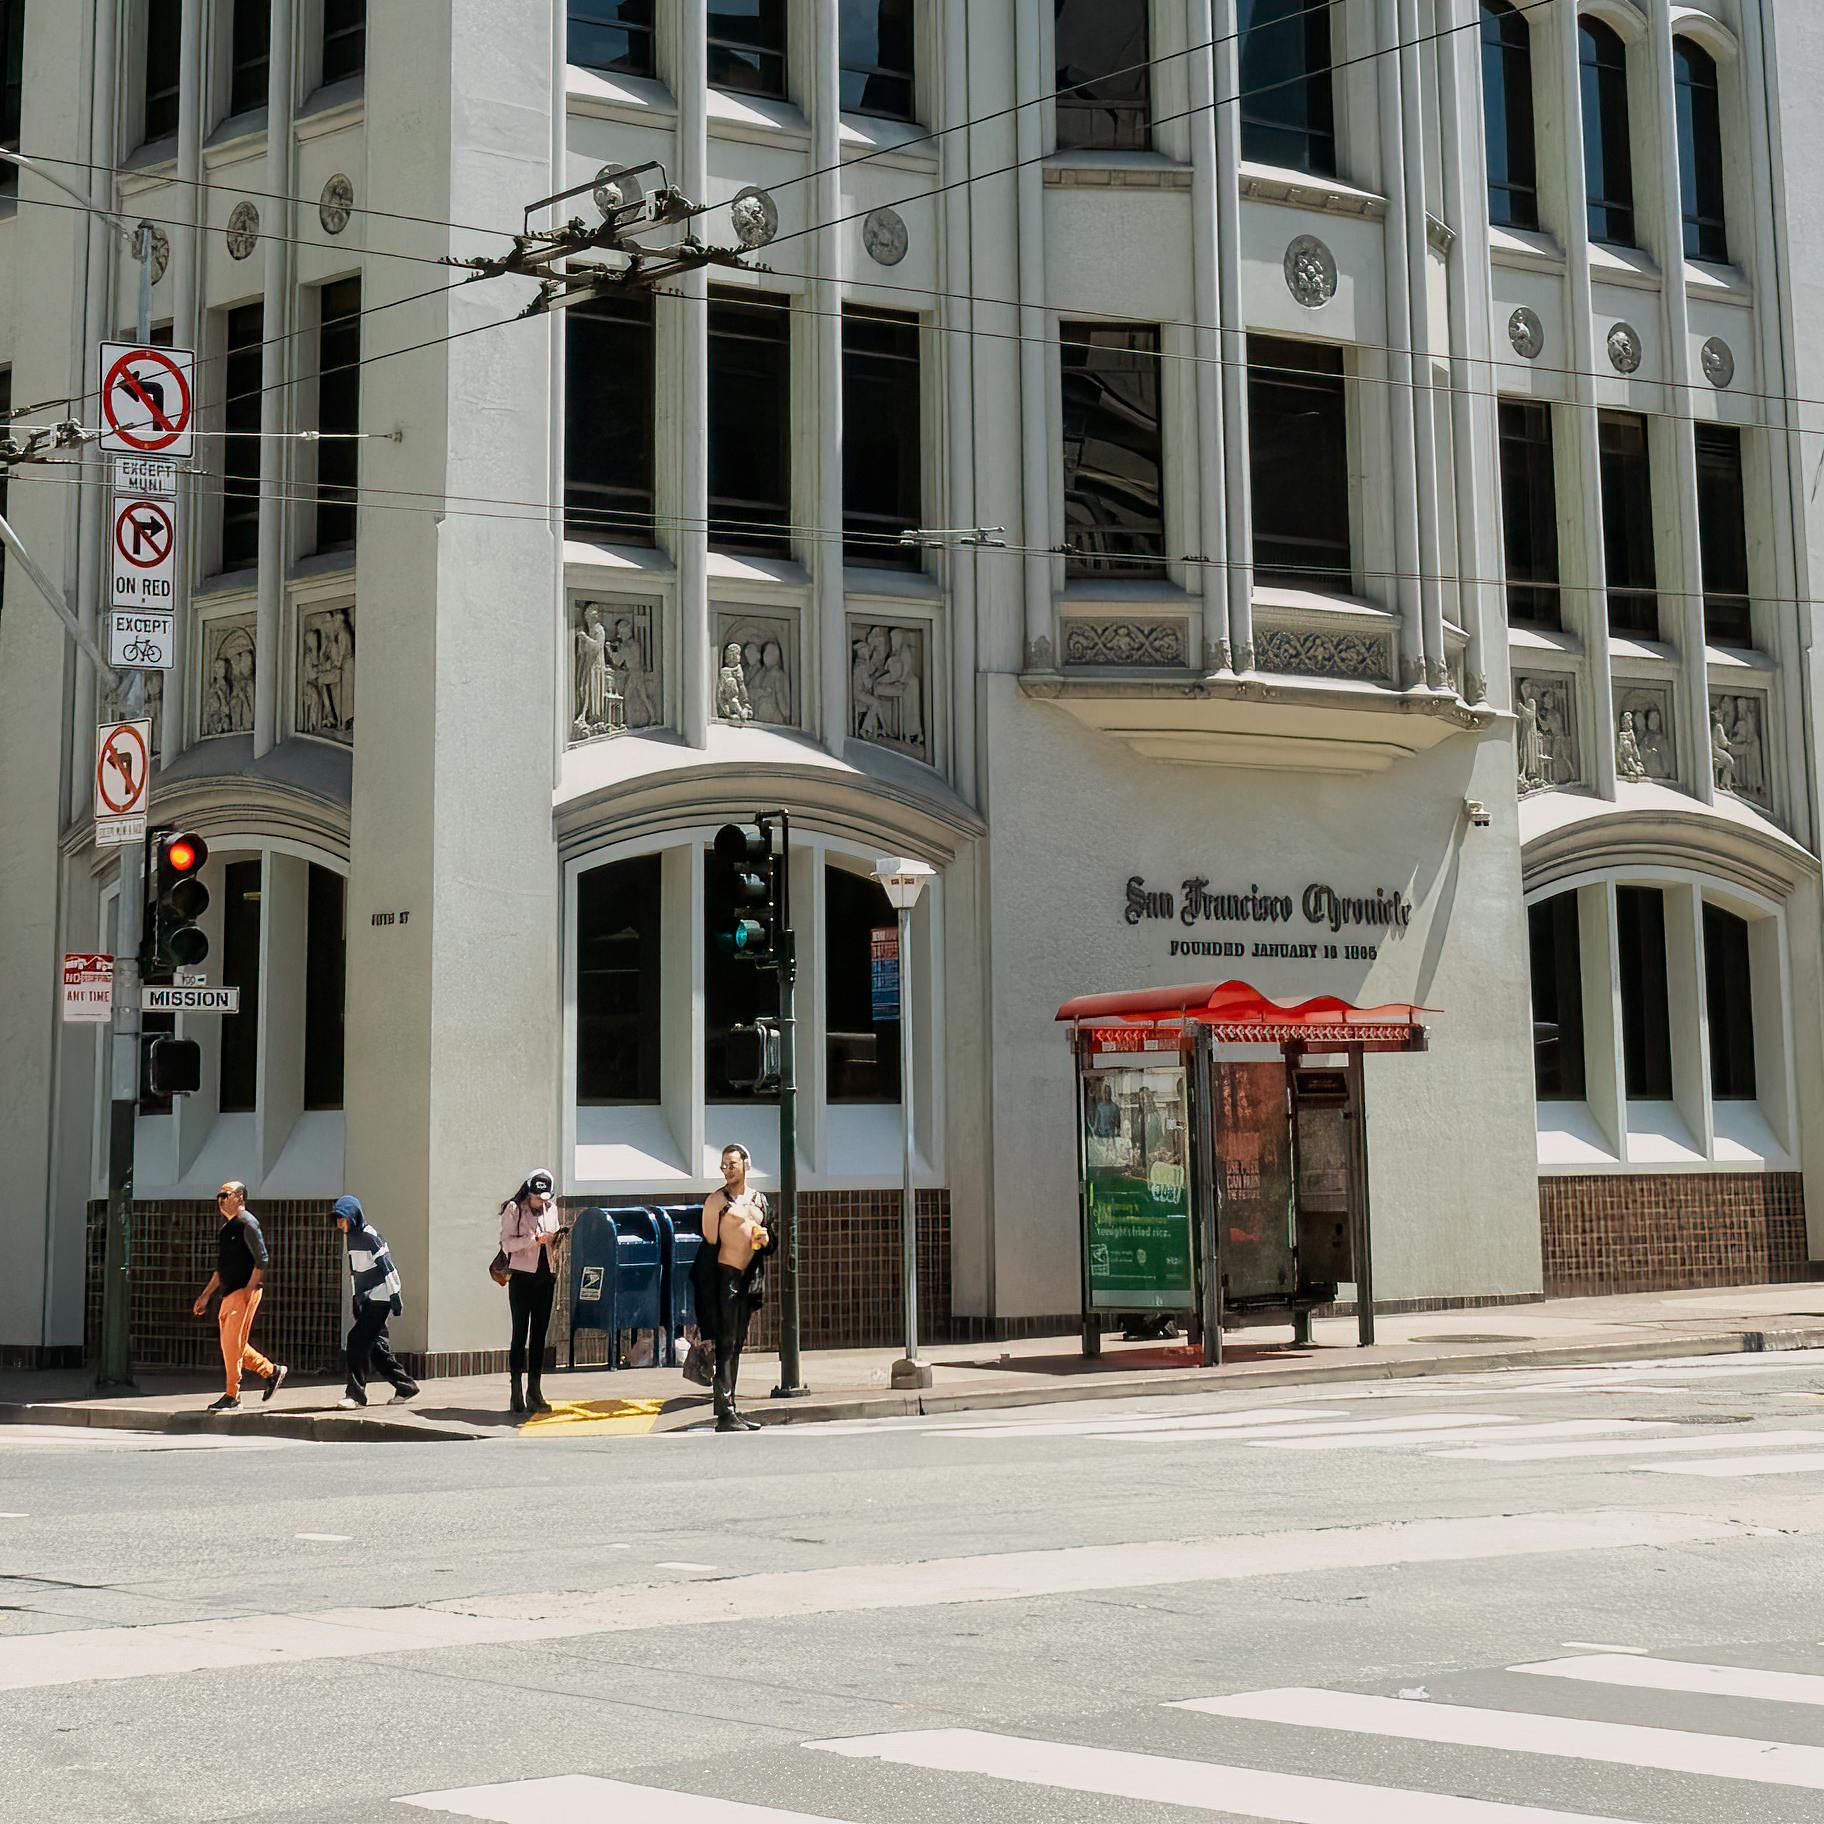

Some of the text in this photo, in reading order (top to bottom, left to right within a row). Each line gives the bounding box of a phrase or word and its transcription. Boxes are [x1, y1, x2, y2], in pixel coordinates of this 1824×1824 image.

[122, 461, 172, 477] EXCEPT
[128, 477, 163, 493] MUNI
[115, 576, 171, 597] ON RED
[116, 617, 169, 634] EXCEPT
[1126, 876, 1412, 932] San Francisco Chronicle
[1170, 940, 1245, 957] FOUNDED
[1251, 942, 1318, 959] JANUARY
[88, 991, 110, 1003] TIME
[150, 991, 229, 1008] MISSION
